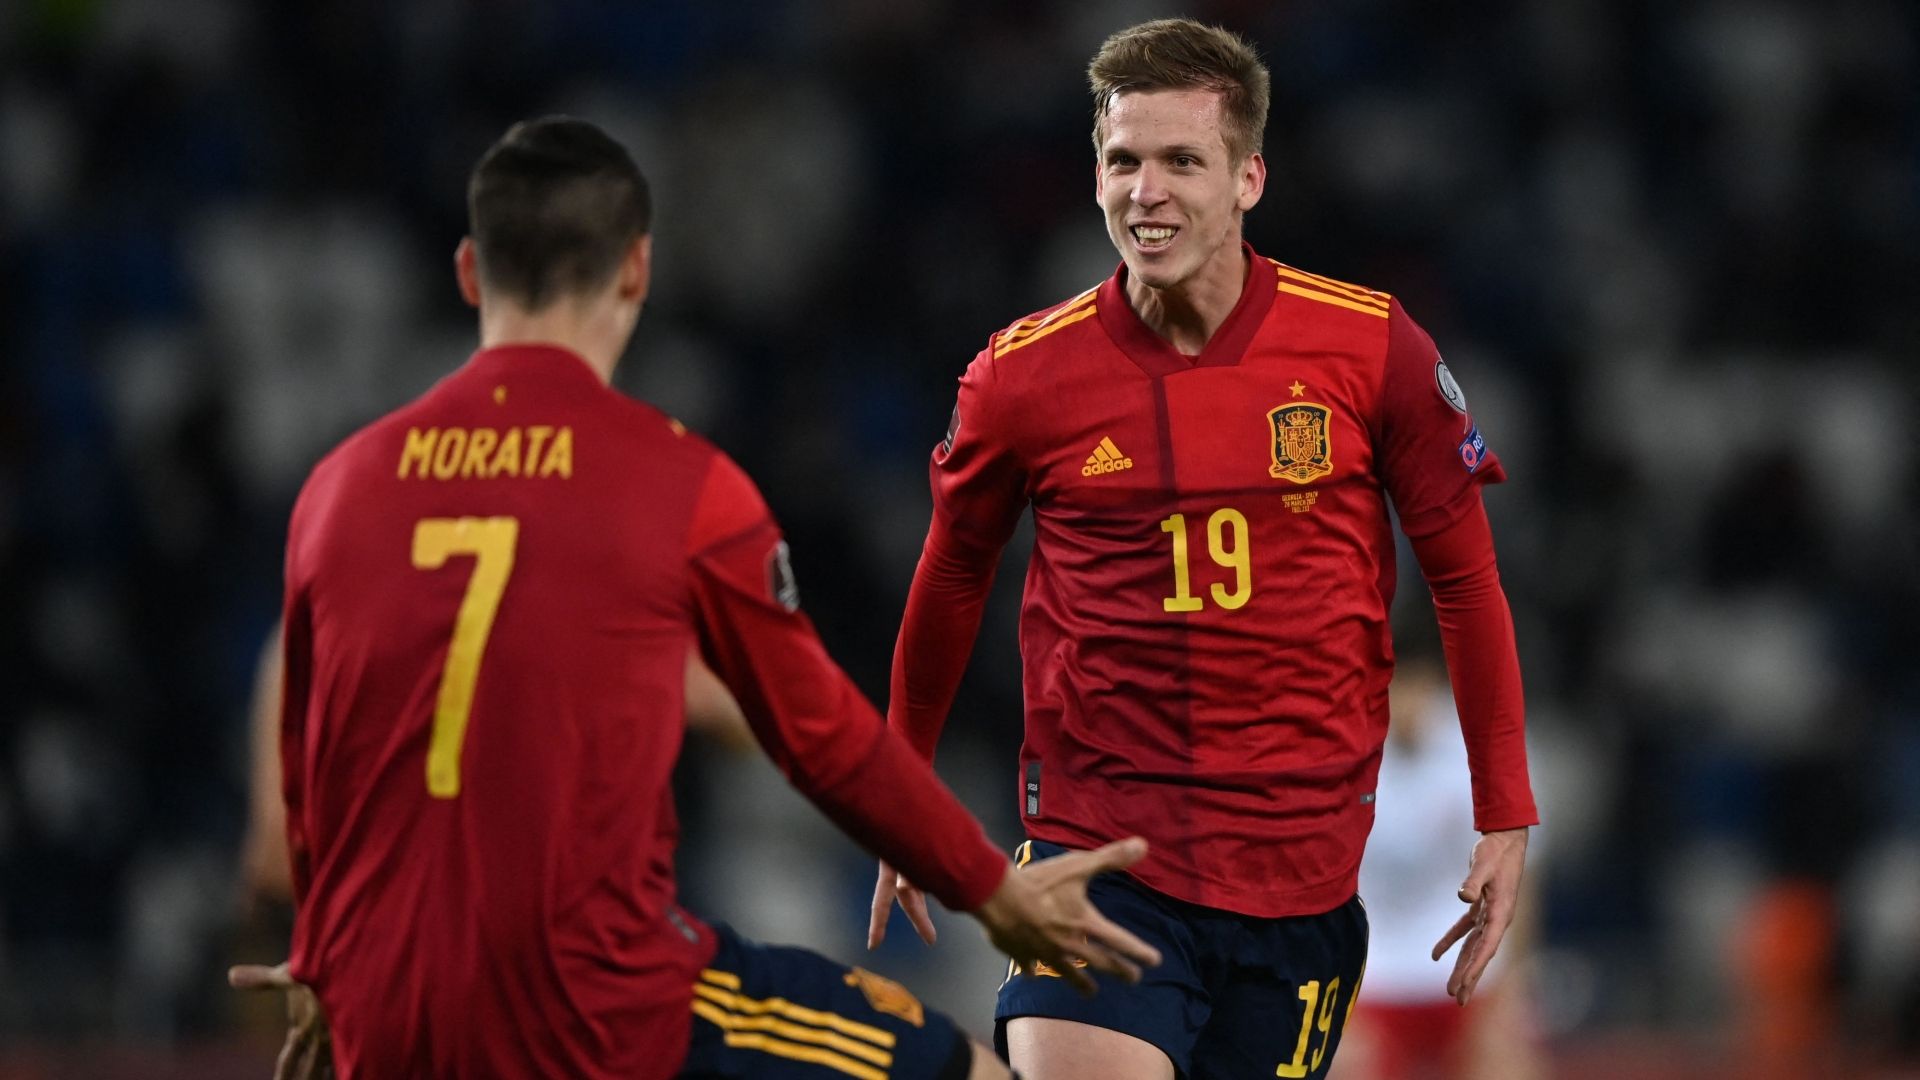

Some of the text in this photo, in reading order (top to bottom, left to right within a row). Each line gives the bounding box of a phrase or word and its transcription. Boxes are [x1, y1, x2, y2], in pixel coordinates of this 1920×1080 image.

[398, 425, 573, 481] MORATA
[1081, 458, 1133, 477] adidas
[1161, 508, 1251, 612] 19
[411, 516, 519, 797] 7
[1277, 976, 1340, 1079] 19
